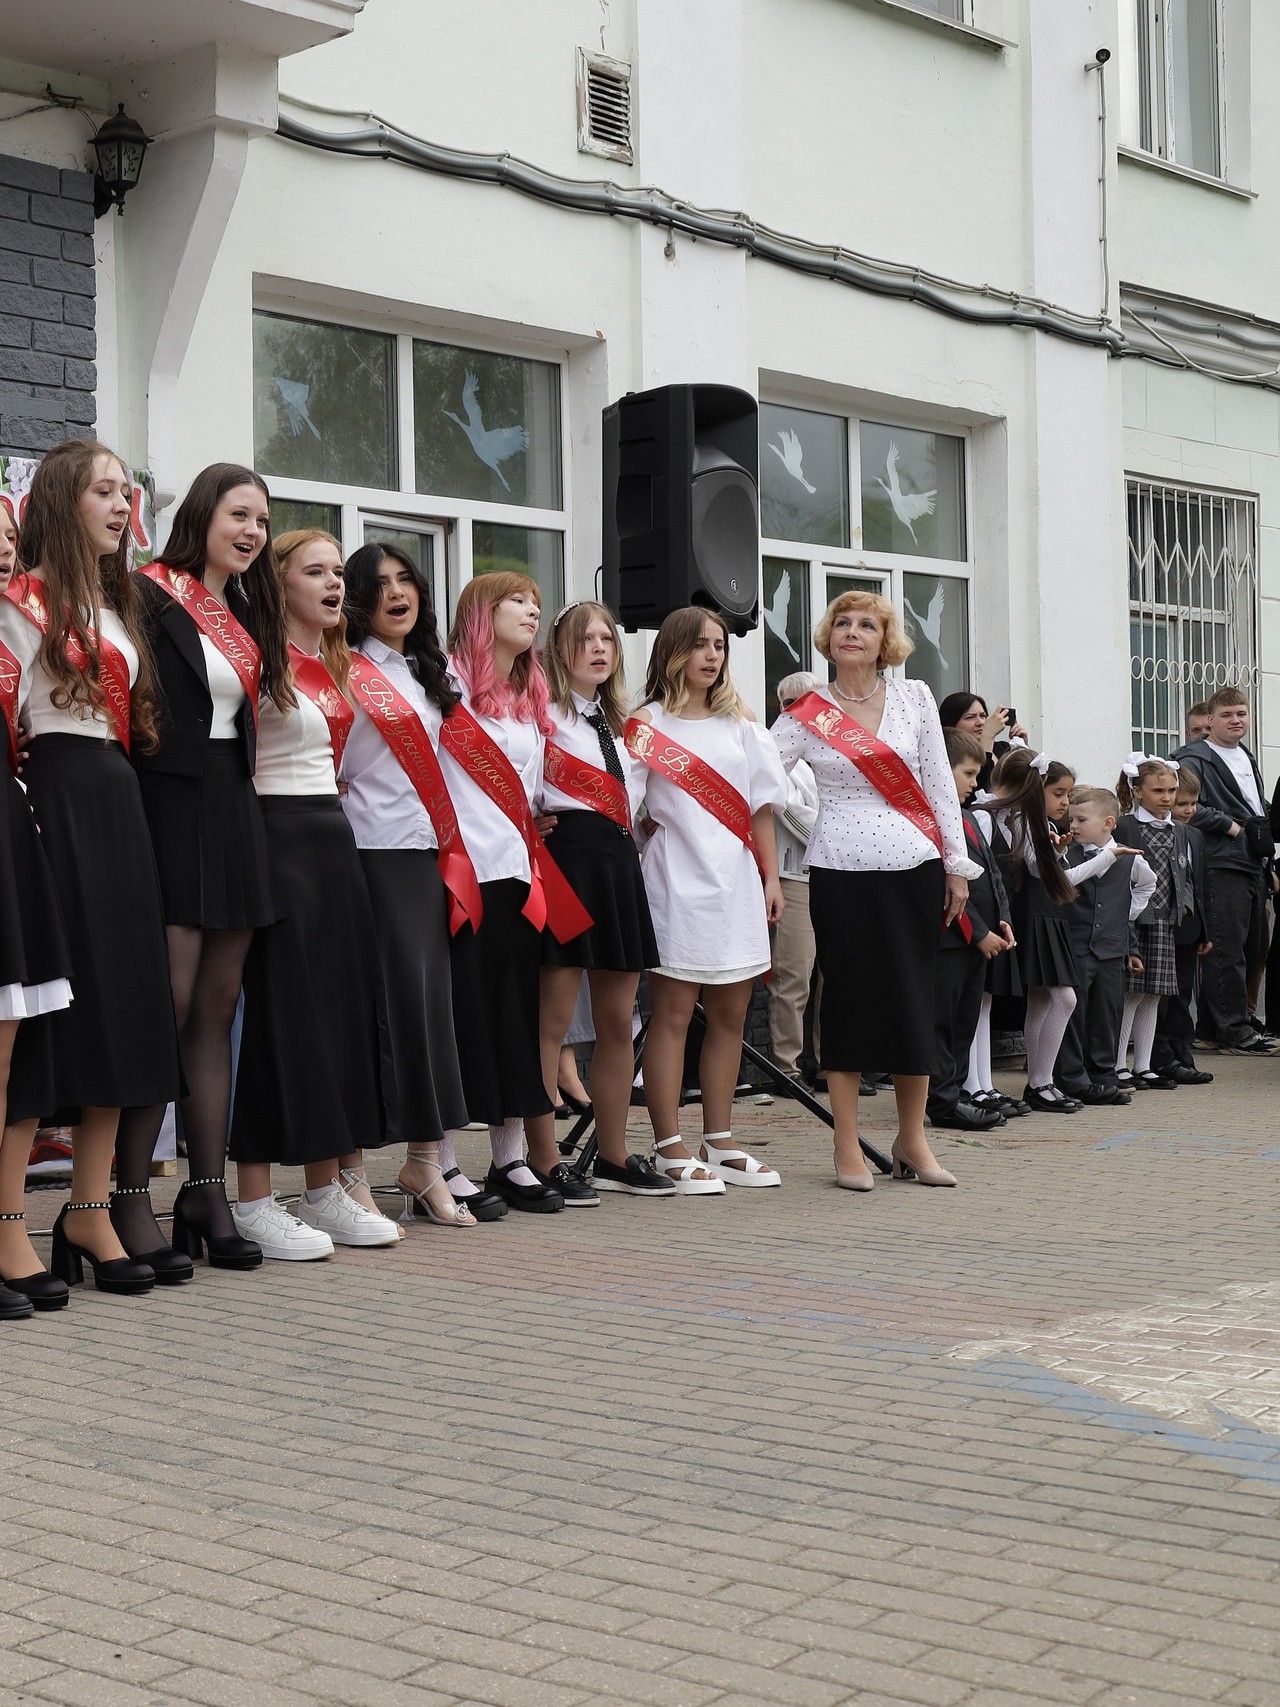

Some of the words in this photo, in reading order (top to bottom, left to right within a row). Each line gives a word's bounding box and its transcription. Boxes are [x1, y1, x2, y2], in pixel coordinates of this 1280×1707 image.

[360, 678, 435, 790] Выпускница
[430, 786, 458, 847] 2025
[658, 746, 746, 827] Выпускница
[840, 728, 901, 787] Классный
